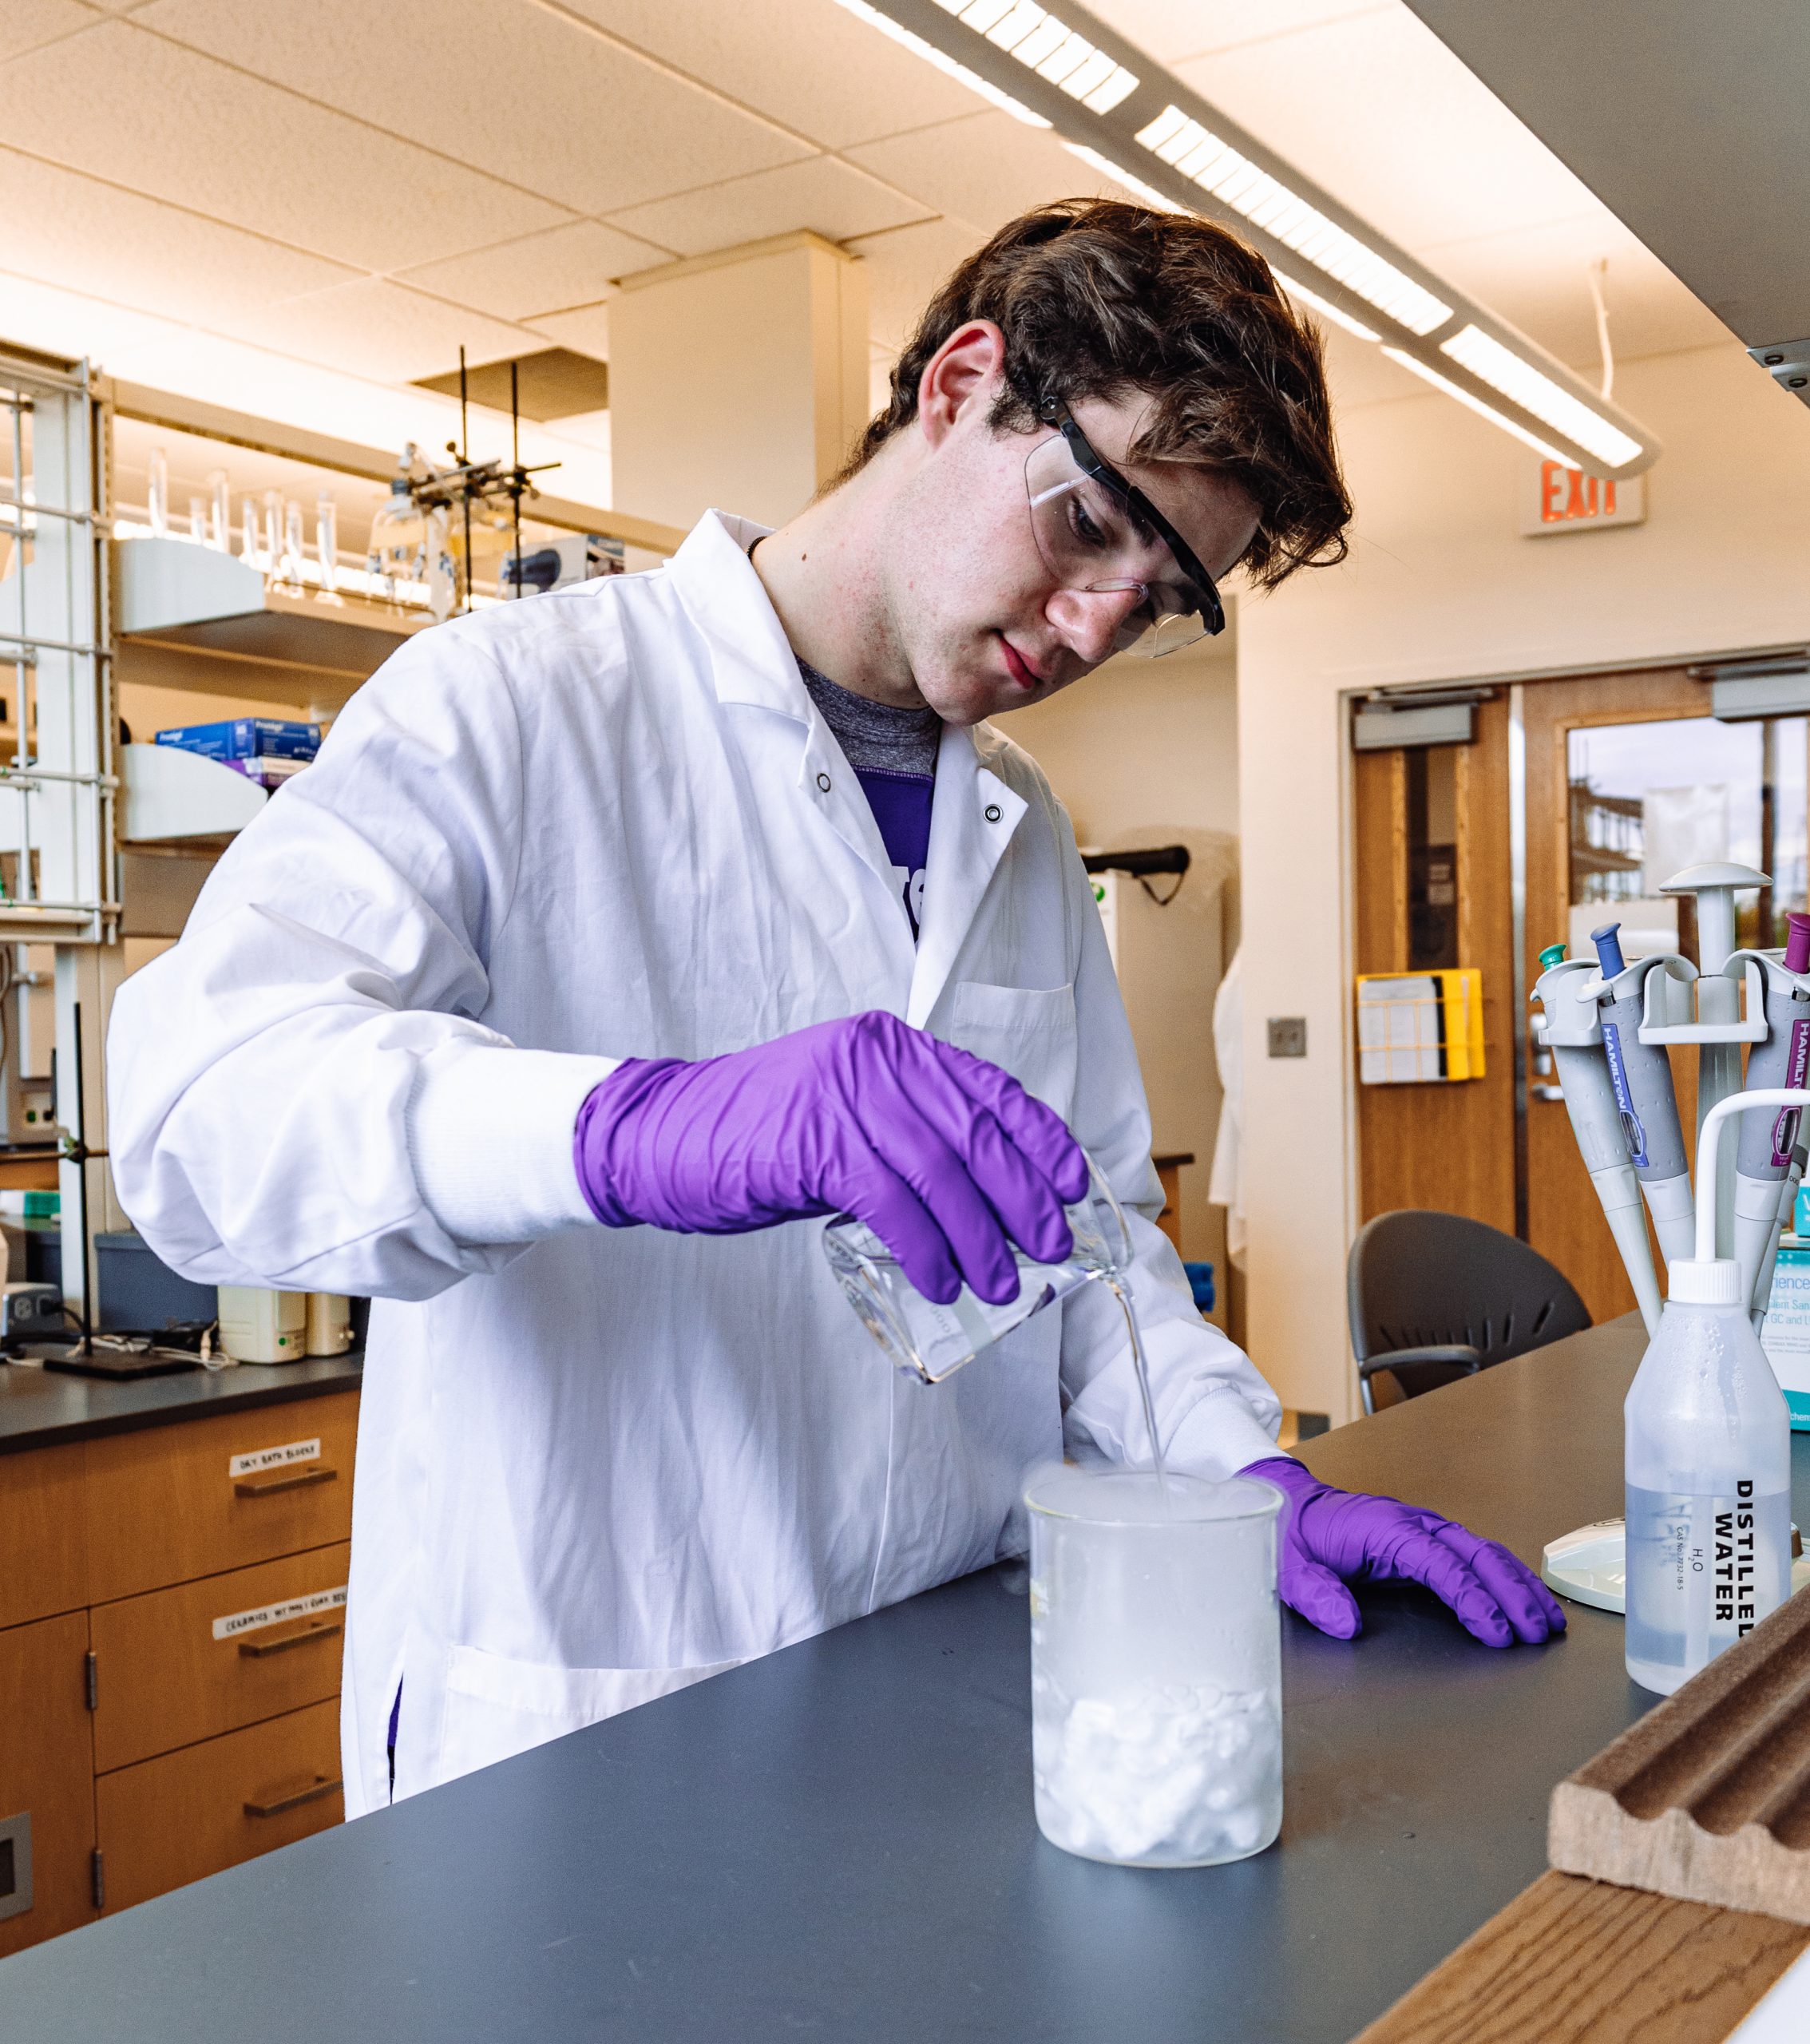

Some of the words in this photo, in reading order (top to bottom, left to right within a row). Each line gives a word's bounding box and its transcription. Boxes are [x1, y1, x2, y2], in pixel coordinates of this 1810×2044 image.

[1604, 1028, 1626, 1109] HAMILTON
[1792, 1023, 1810, 1089] HAMILT
[1773, 1273, 1810, 1289] ience
[1786, 1316, 1802, 1325] and
[1715, 1512, 1733, 1621] WATER
